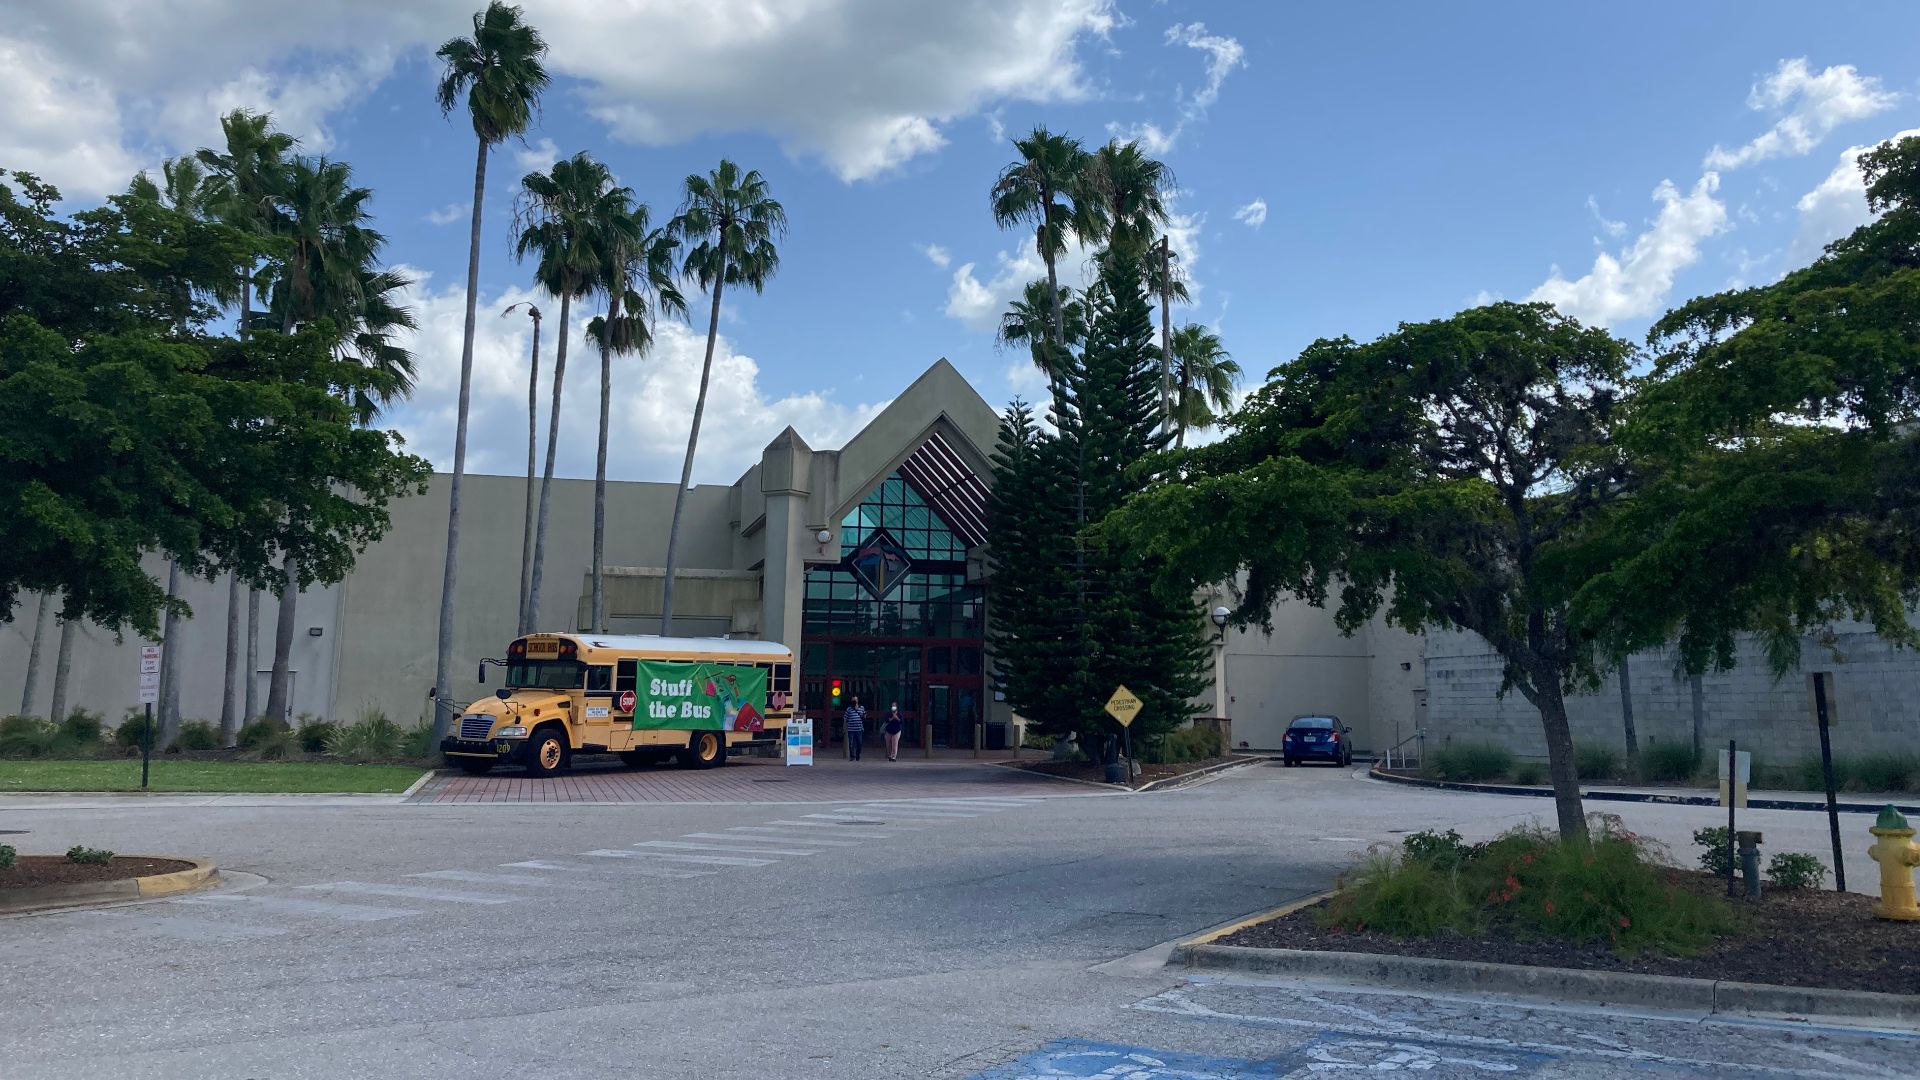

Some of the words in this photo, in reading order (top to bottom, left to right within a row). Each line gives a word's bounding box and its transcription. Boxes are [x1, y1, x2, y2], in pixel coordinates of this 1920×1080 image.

[528, 643, 546, 653] SCHOOL
[547, 643, 558, 653] BUS
[650, 679, 692, 696] Stuff
[622, 697, 635, 706] STOP
[649, 701, 677, 718] the
[680, 702, 711, 719] Bus
[496, 743, 511, 753] 1209
